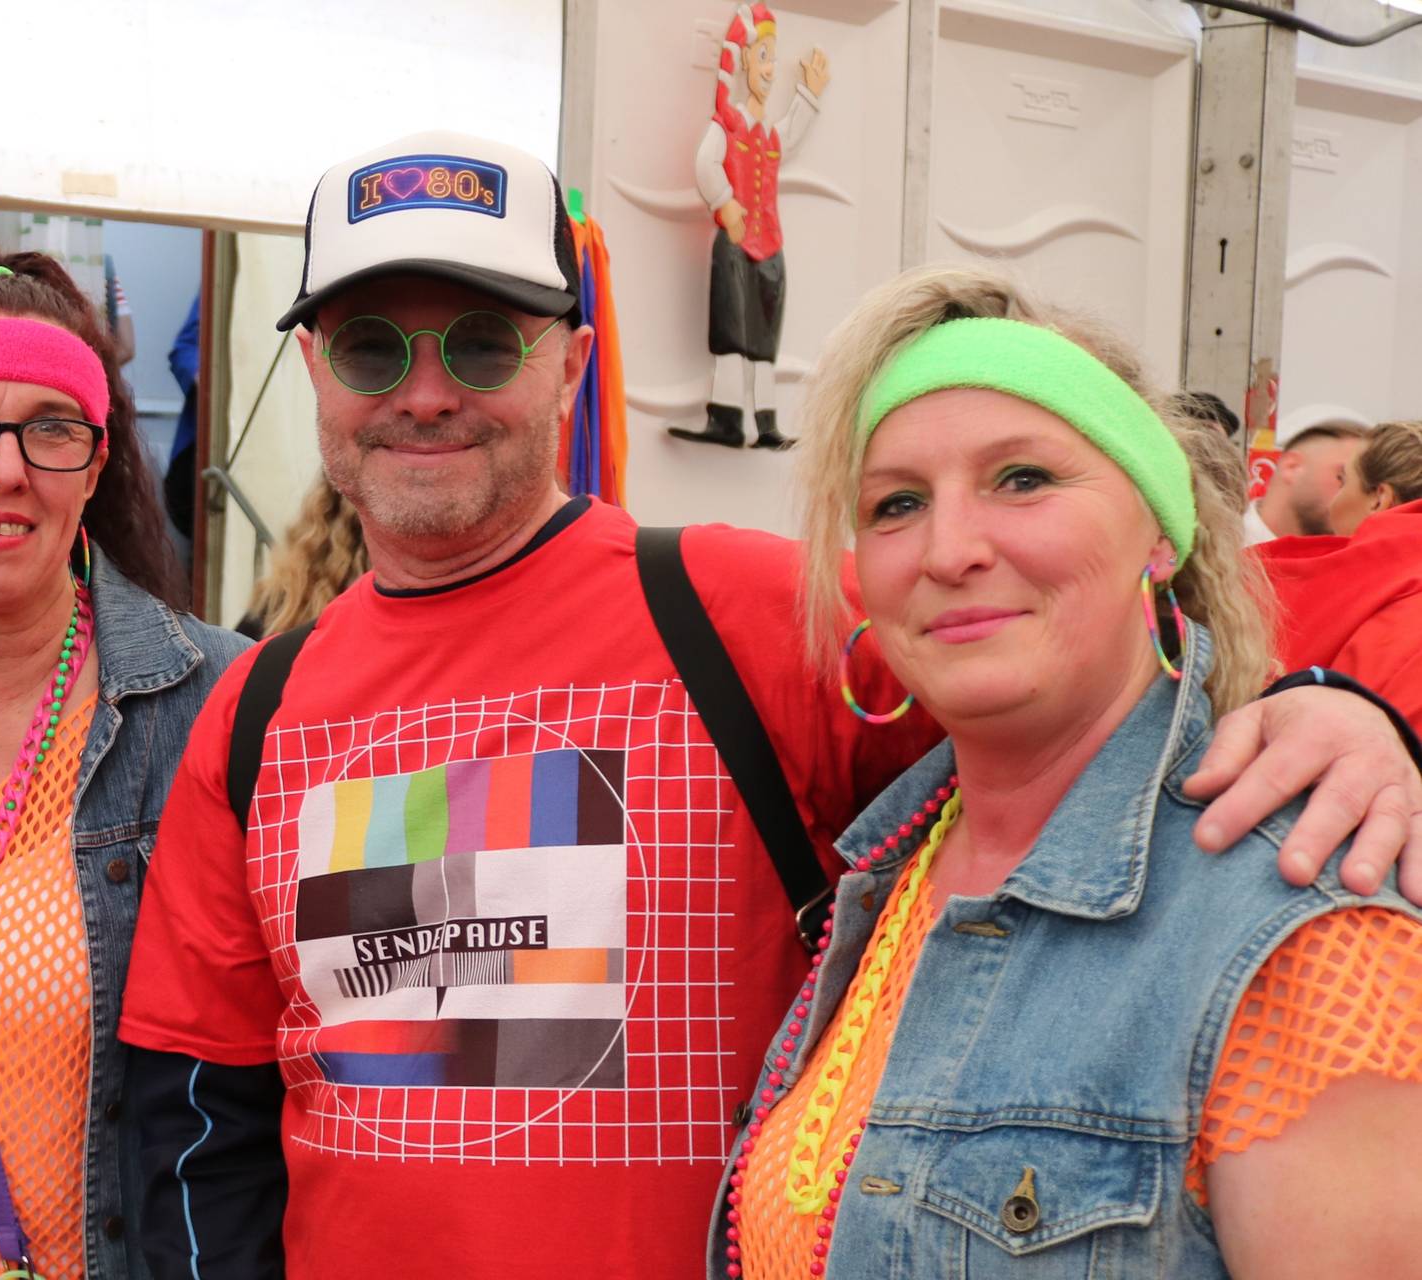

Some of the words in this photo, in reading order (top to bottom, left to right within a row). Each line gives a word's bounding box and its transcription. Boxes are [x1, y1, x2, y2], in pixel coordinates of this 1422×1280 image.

[360, 173, 383, 211] I
[427, 167, 494, 206] 80's
[356, 919, 546, 962] SENDEPAUSE
